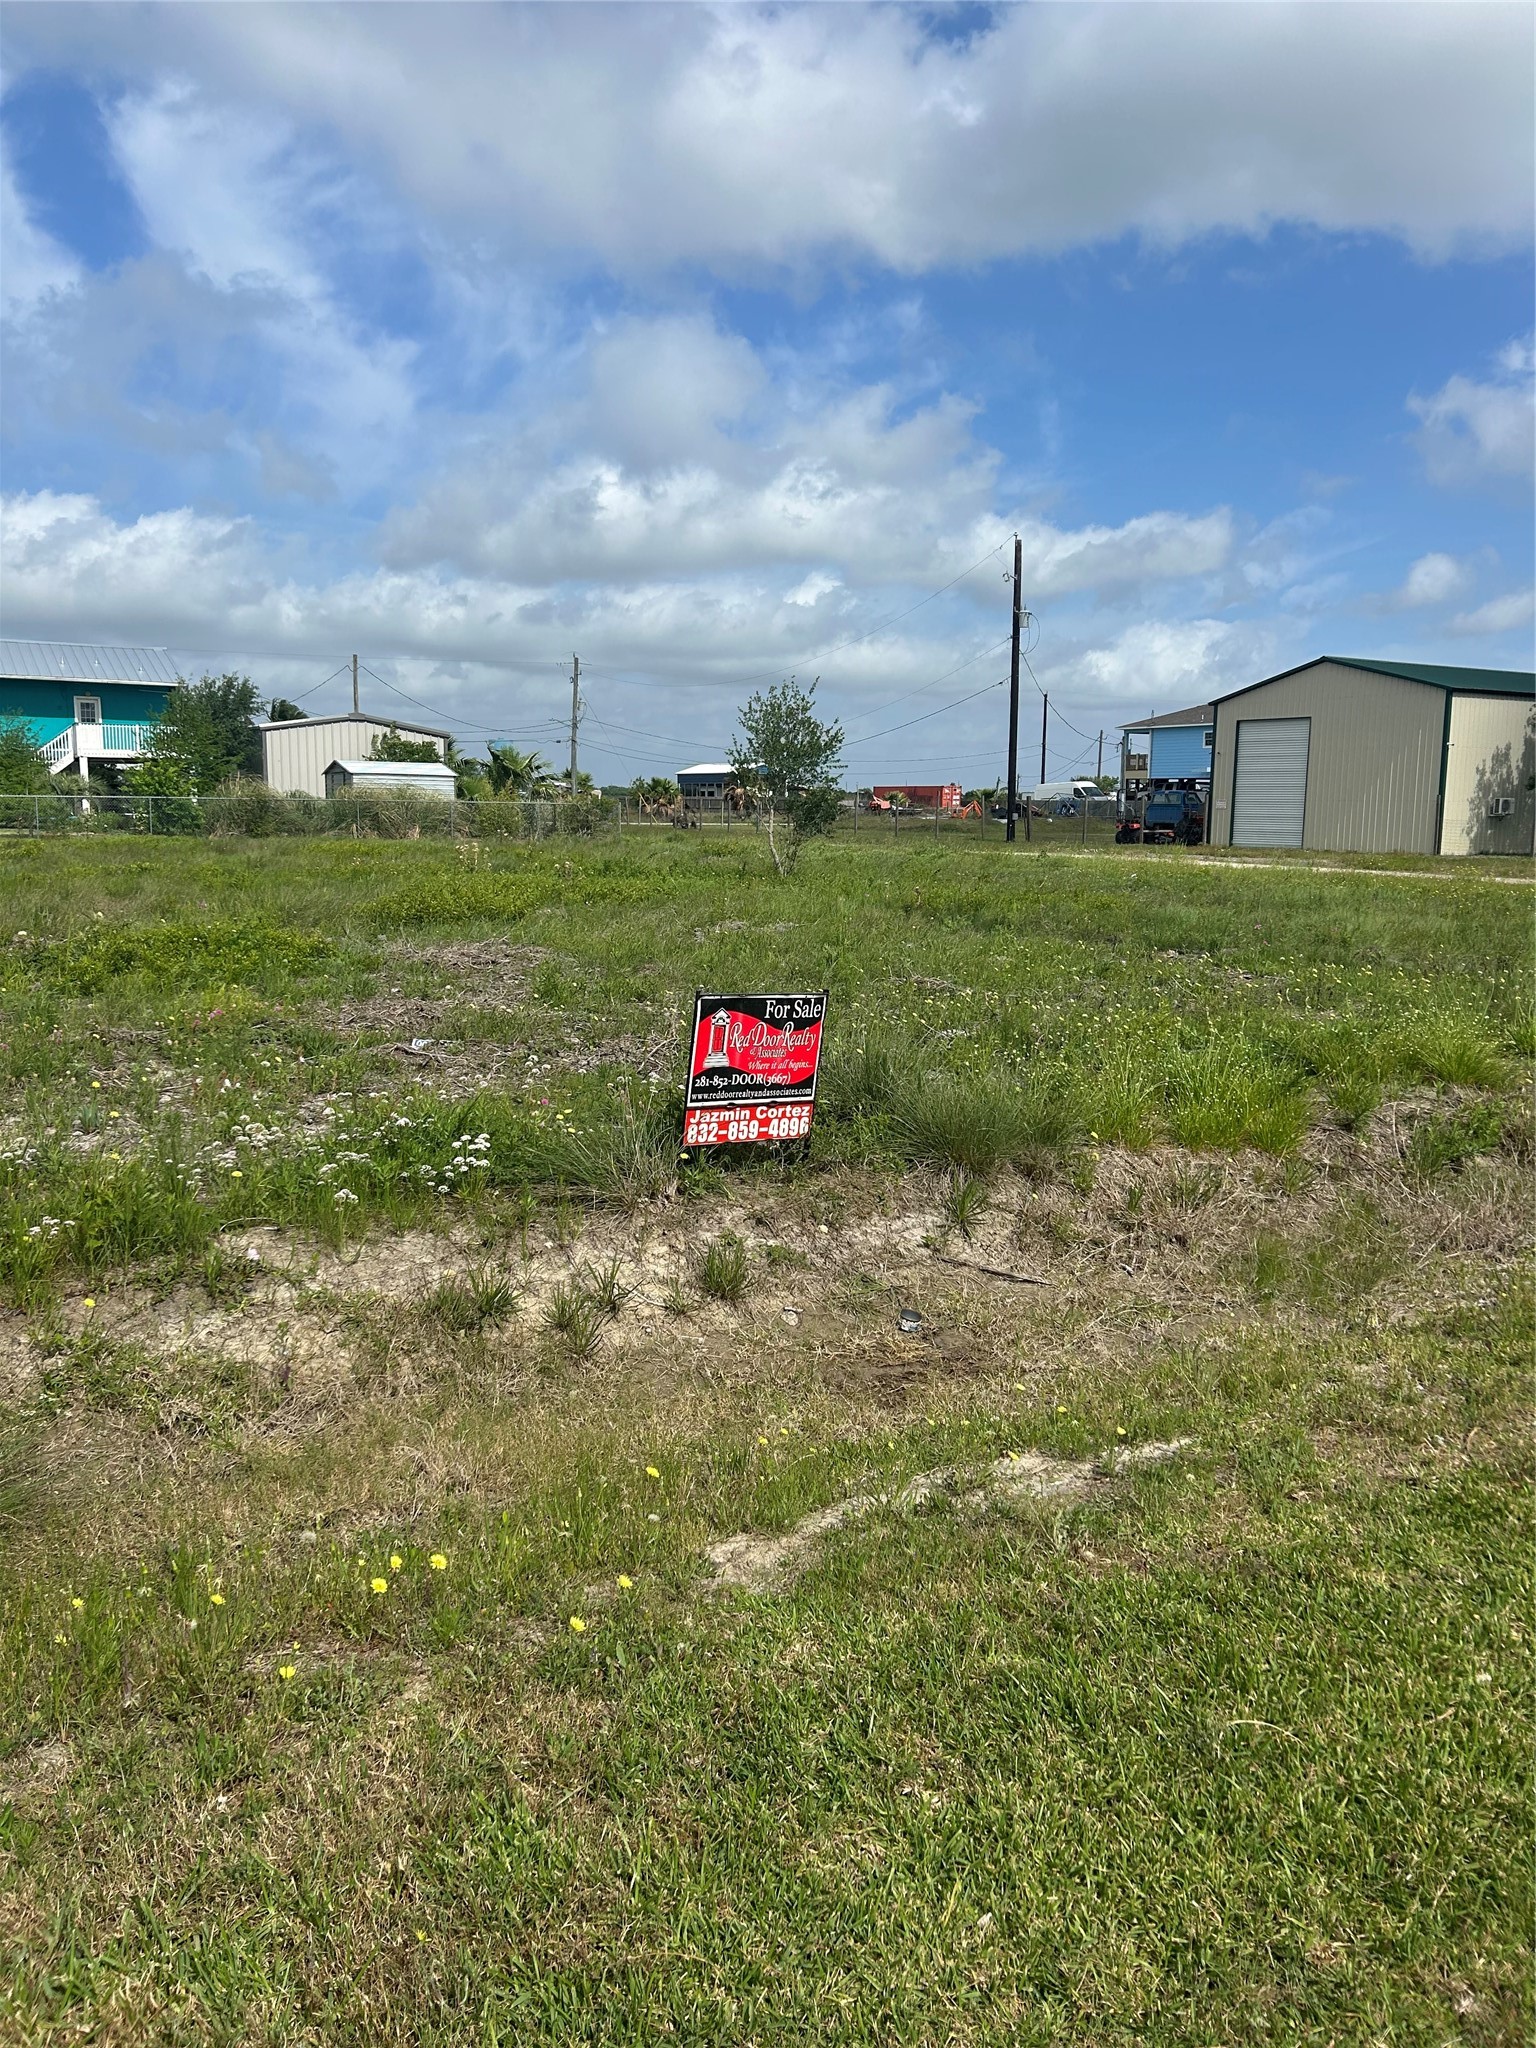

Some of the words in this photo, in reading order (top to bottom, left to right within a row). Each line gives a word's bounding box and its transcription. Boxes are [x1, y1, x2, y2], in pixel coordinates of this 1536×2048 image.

[764, 1000, 790, 1019] For
[793, 999, 822, 1018] Sale
[730, 1022, 750, 1053] Red
[751, 1023, 783, 1047] Door
[782, 1022, 816, 1051] Realty
[755, 1047, 787, 1058] Associates
[748, 1061, 769, 1071] Where
[771, 1061, 777, 1070] it
[778, 1060, 787, 1069] all
[692, 1088, 812, 1100] www.reddoorrealtyandassociates.com
[690, 1109, 750, 1123] Jazmin
[756, 1106, 810, 1119] Cortez
[687, 1117, 809, 1143] 832-859-4896
